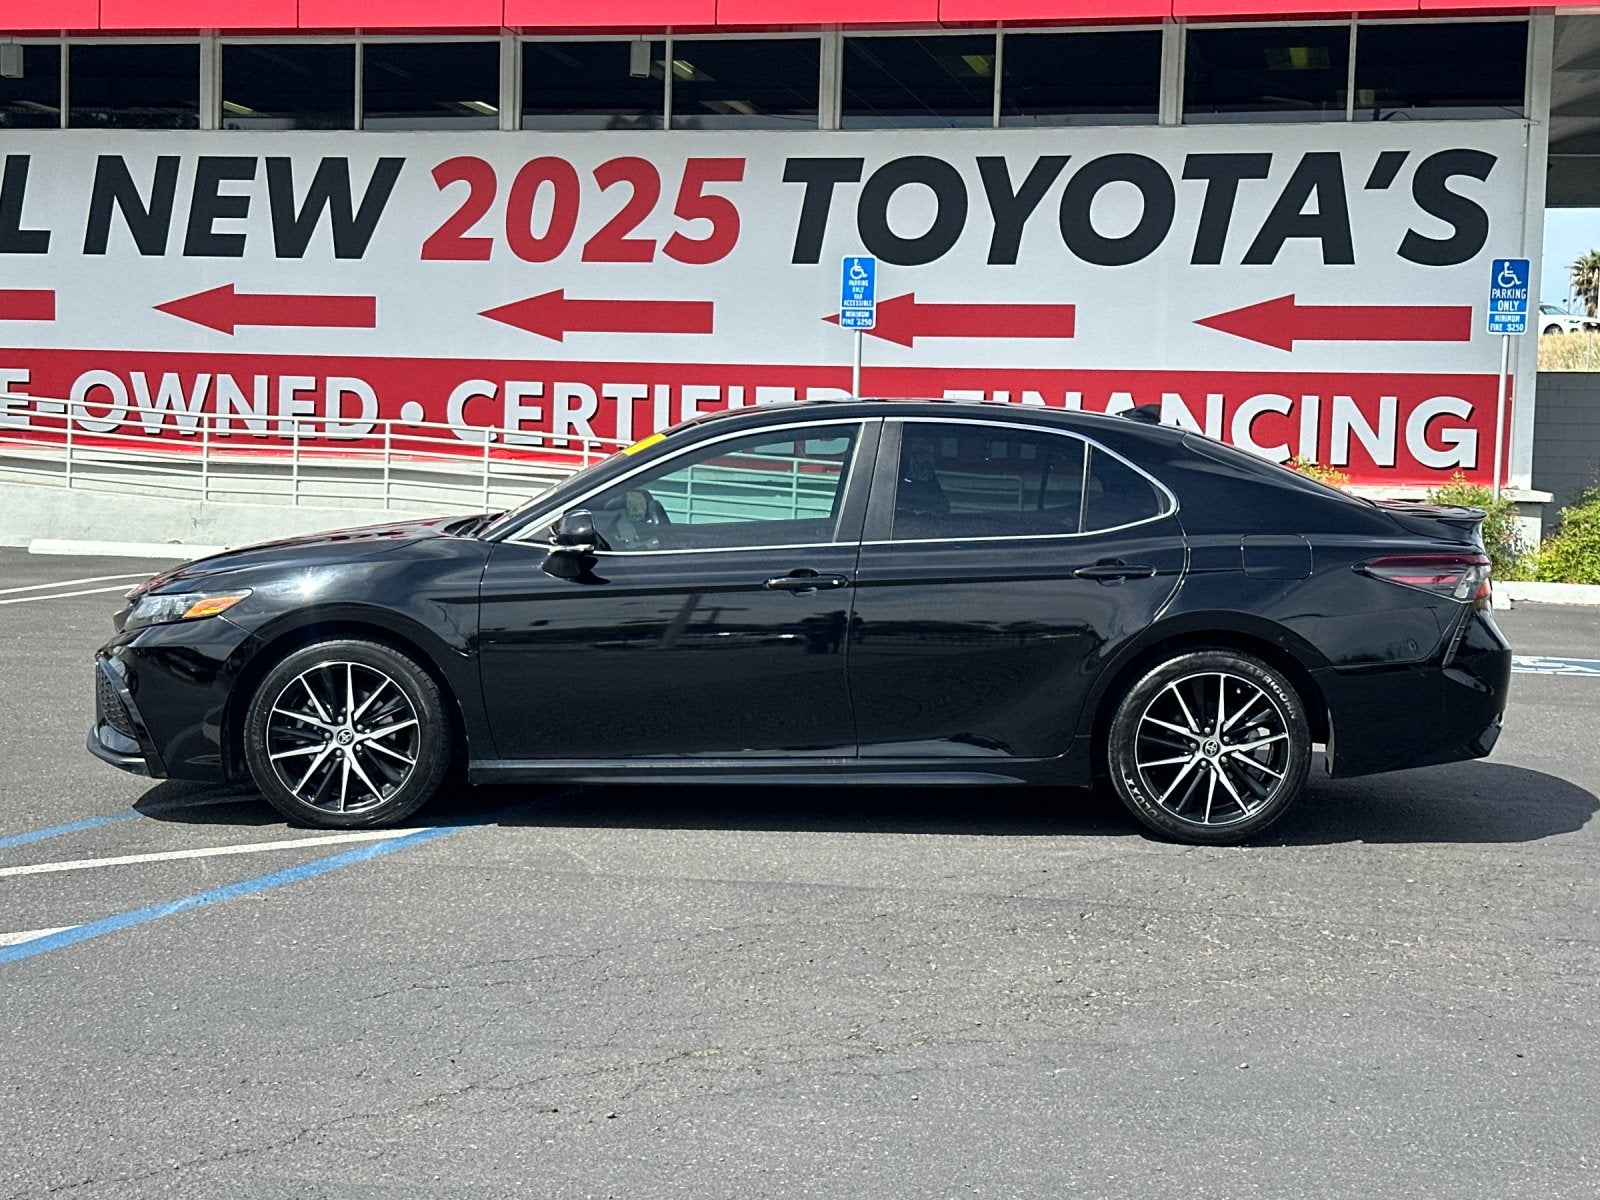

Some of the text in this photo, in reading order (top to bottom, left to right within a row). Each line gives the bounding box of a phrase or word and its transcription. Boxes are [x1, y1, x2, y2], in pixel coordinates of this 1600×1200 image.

[83, 155, 406, 259] NEW
[422, 156, 745, 264] 2025
[782, 149, 1497, 266] TOYOTA'S
[1492, 288, 1527, 299] PARKING
[1497, 300, 1520, 311] ONLY
[856, 318, 872, 326] $250
[1490, 323, 1524, 331] FINE $250
